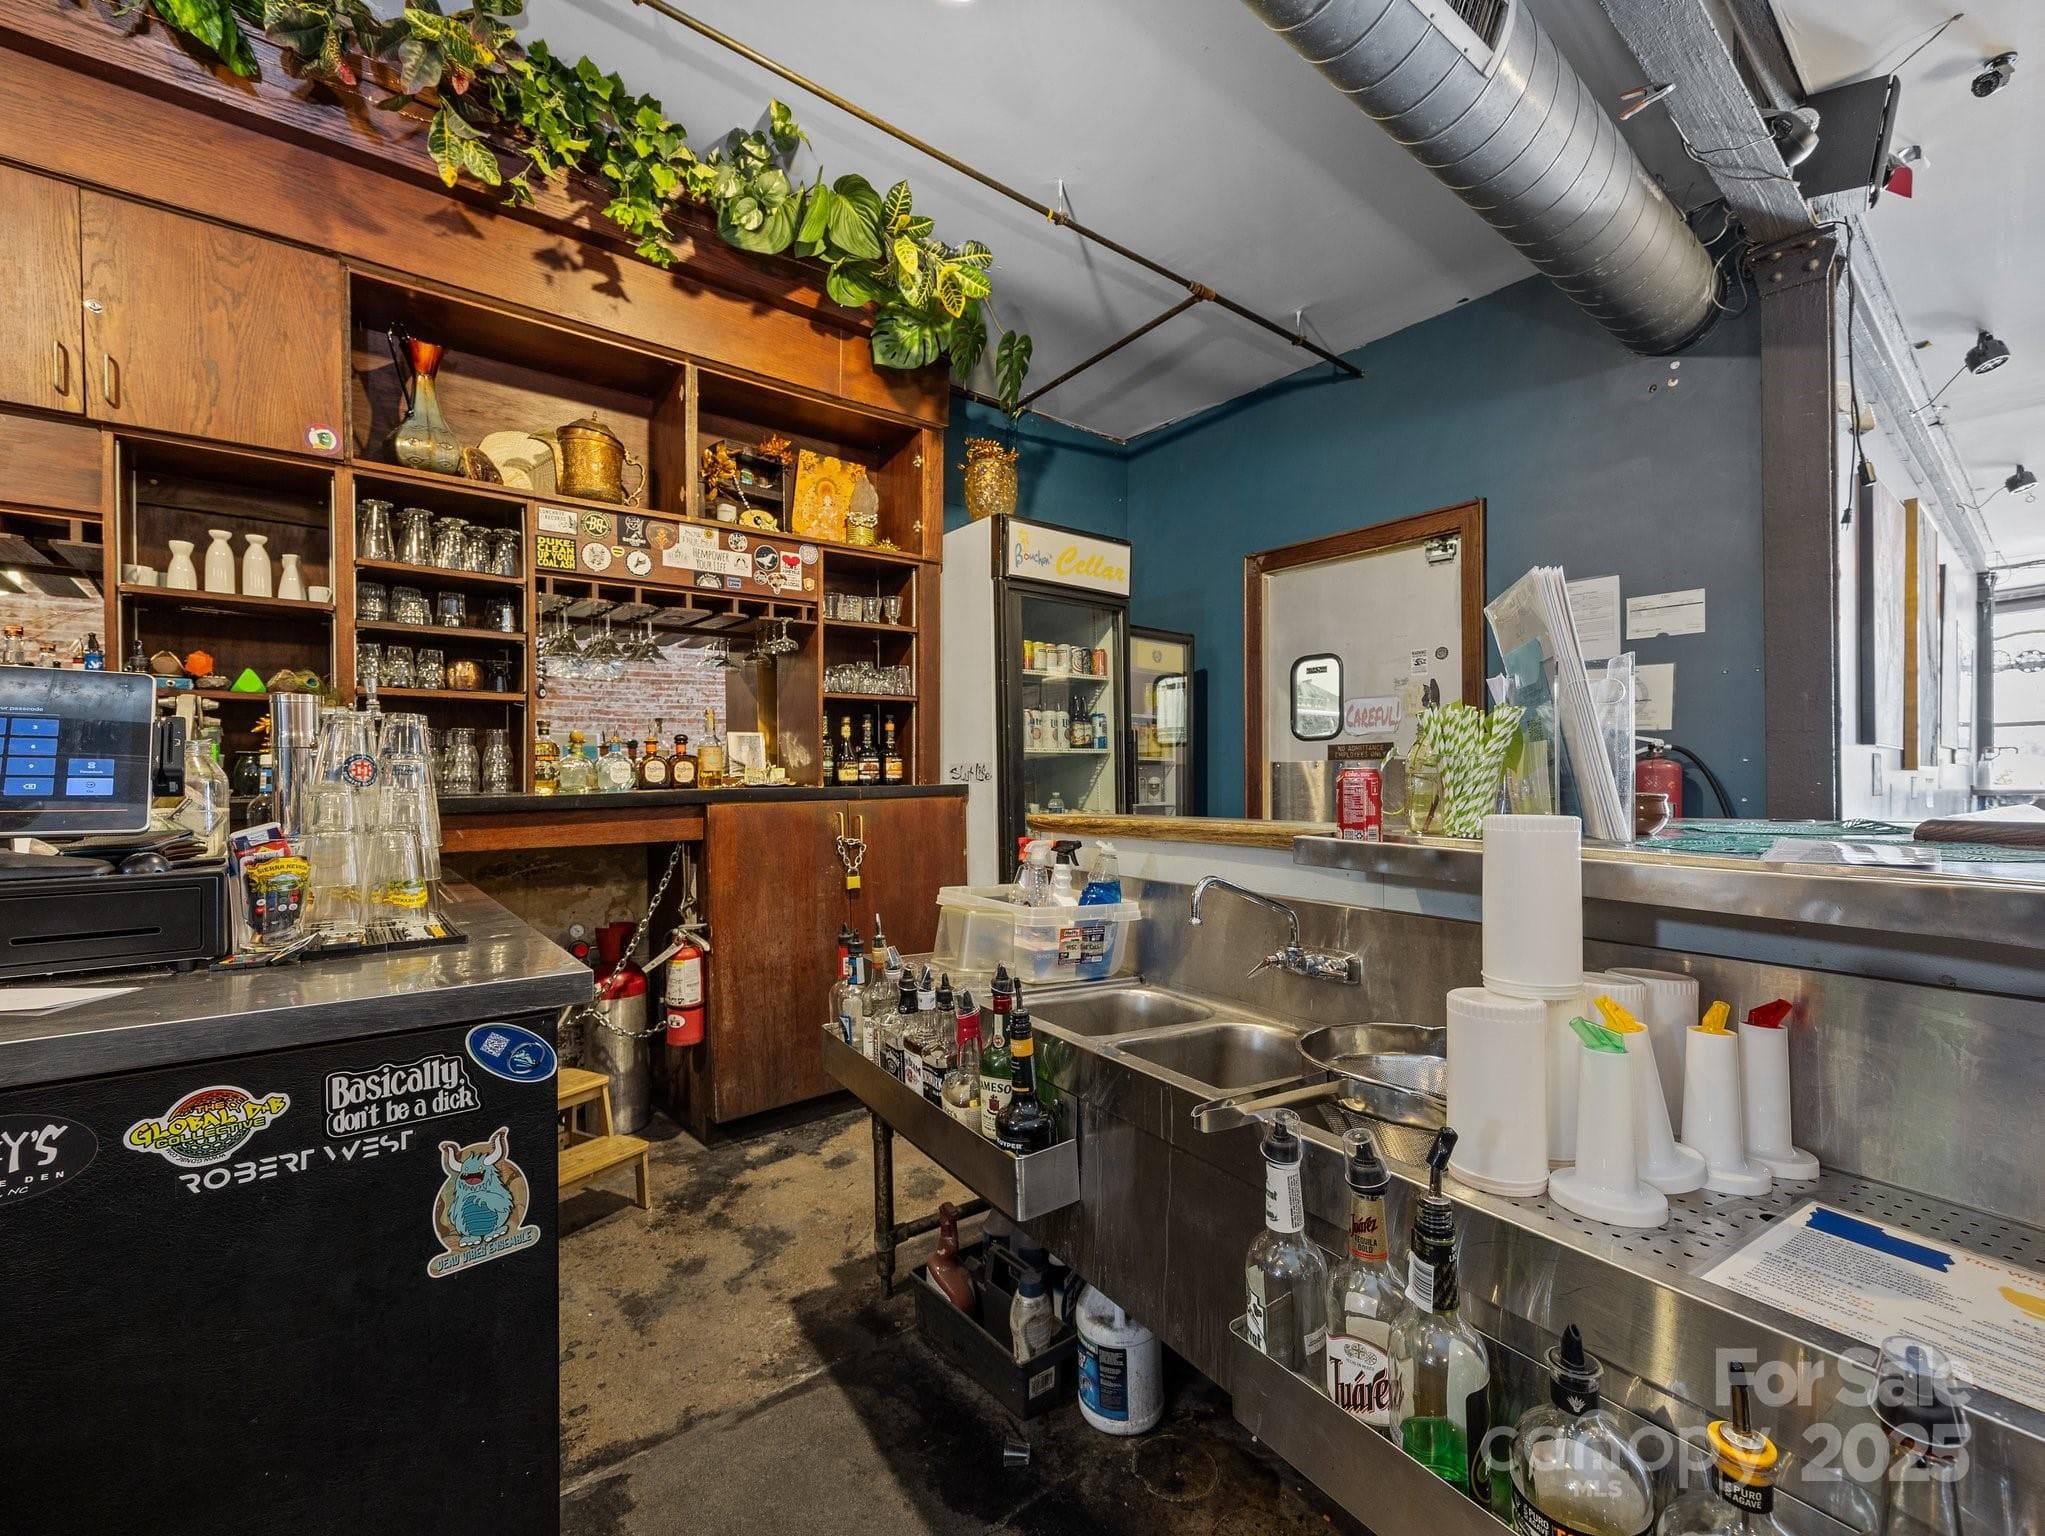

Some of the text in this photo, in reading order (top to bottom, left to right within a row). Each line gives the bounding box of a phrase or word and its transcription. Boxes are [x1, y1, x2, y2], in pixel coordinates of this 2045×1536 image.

[537, 536, 575, 547] DUKE:
[537, 545, 575, 555] CLEAN
[537, 551, 575, 562] UP YOUR
[537, 558, 576, 570] COAL ASH
[1055, 545, 1126, 583] Cellar
[980, 1080, 1011, 1094] AMESO
[195, 1101, 225, 1113] THE
[332, 1085, 475, 1133] don't be a dick
[129, 1108, 238, 1149] GLOBAL
[154, 1116, 266, 1150] COLLECTIVE
[0, 1124, 69, 1174] Y'S
[179, 1130, 414, 1194] ROBERT WEST
[24, 1171, 65, 1184] DEN
[437, 1230, 533, 1271] DEAD VIBES ENSEMBLE
[1357, 1243, 1374, 1254] GOLD
[1732, 1492, 1763, 1510] AGAVE
[1733, 1485, 1763, 1502] PURO
[1528, 1506, 1550, 1530] PURO
